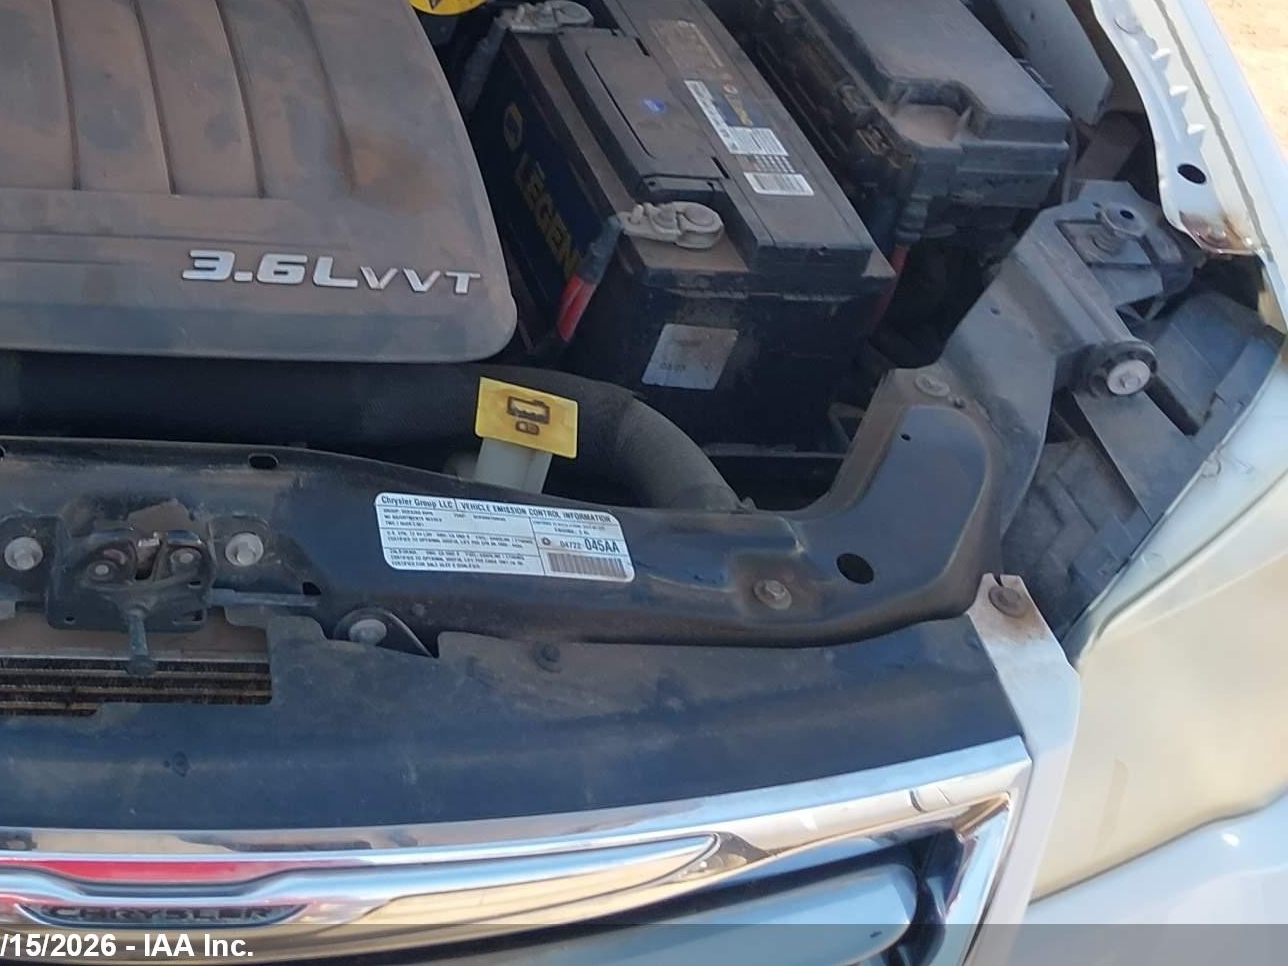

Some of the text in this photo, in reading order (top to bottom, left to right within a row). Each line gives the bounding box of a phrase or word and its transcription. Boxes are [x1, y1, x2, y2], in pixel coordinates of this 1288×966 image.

[381, 495, 453, 509] Chrysler Group LLC
[462, 502, 612, 523] VEHICLE EMISSION CONTROL INFORMATION
[584, 537, 621, 554] 045AA
[48, 904, 272, 923] CHRYSLER
